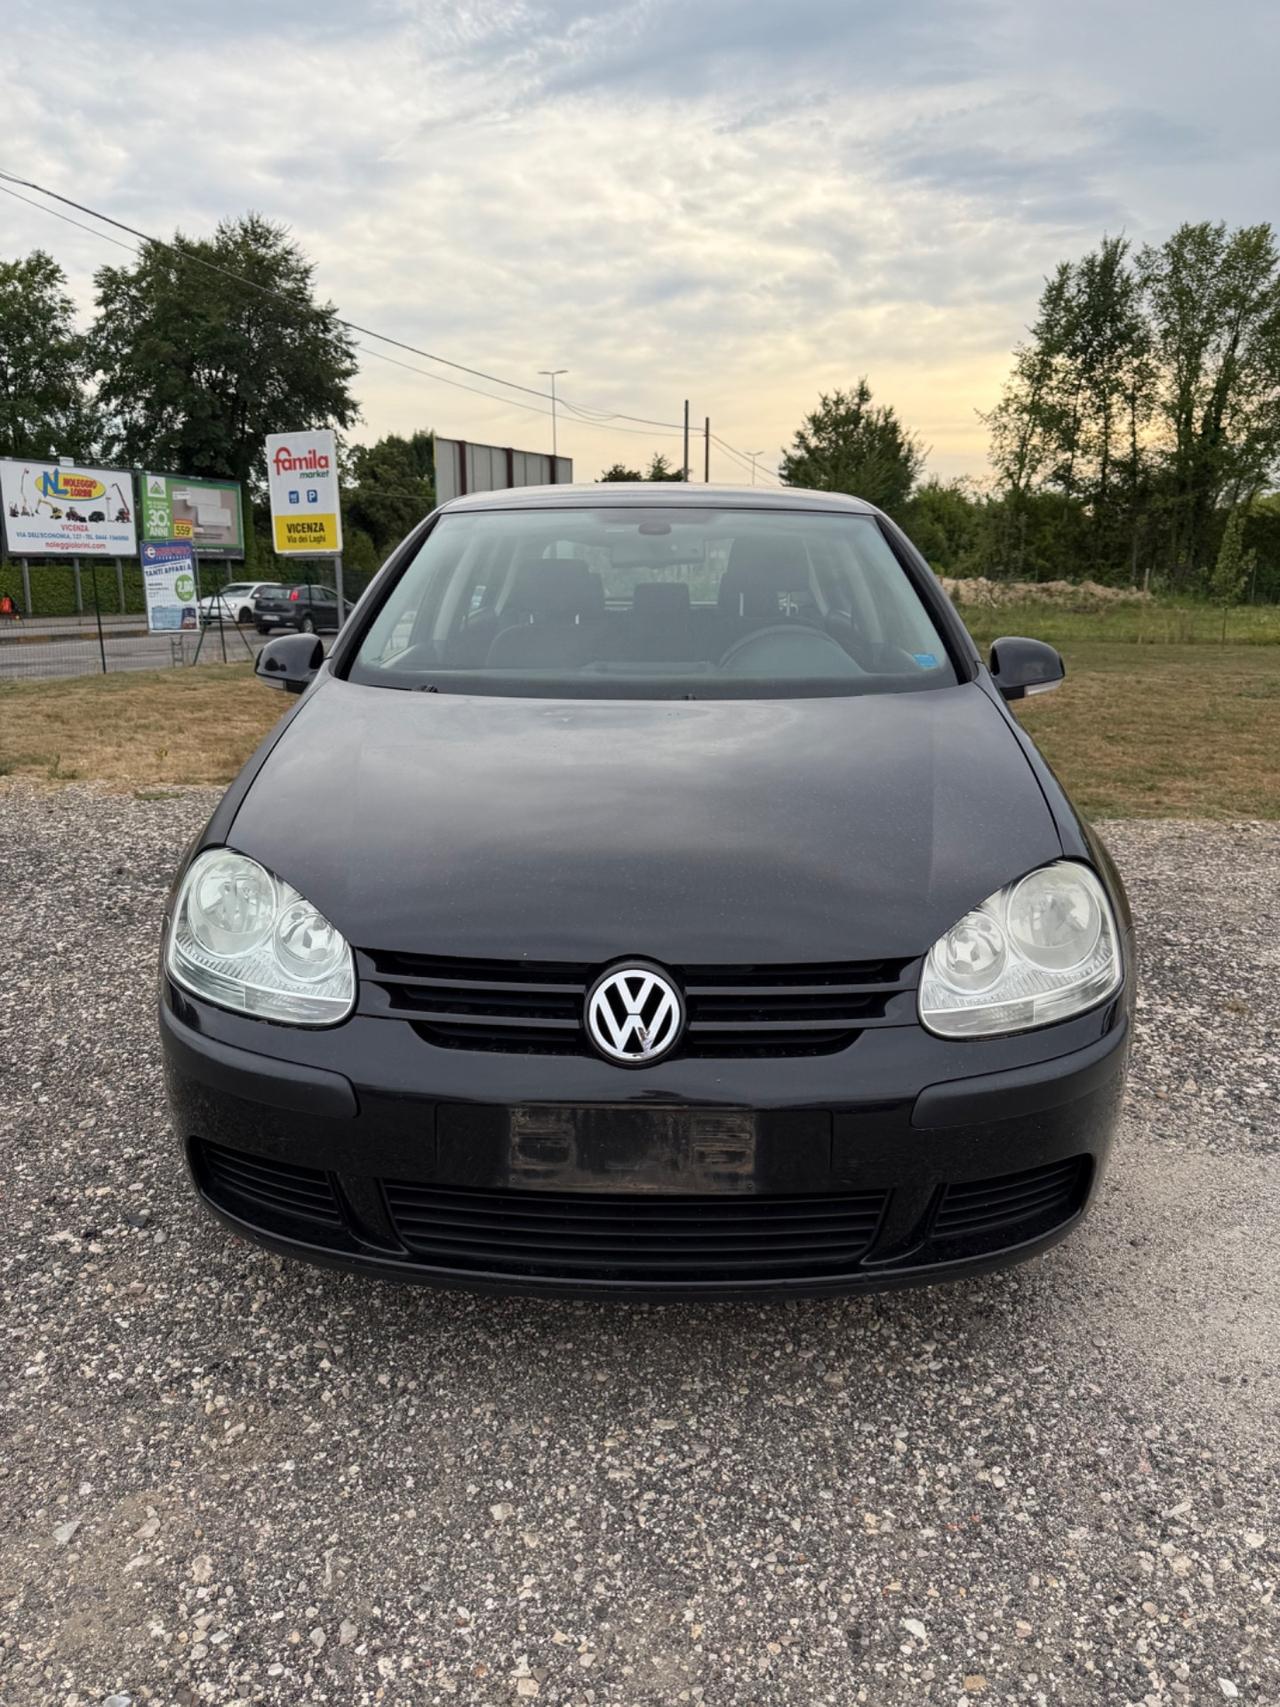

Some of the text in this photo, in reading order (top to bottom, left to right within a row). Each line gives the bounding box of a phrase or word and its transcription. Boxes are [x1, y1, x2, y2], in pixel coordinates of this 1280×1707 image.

[273, 447, 329, 475] famila
[300, 470, 329, 479] market
[63, 478, 97, 488] NOLEGGIO
[61, 524, 89, 532] VICENZA
[149, 526, 168, 536] ANNI
[286, 521, 325, 534] VICENZA
[287, 533, 326, 544] Via dei Laghi
[164, 565, 186, 573] AFFARI
